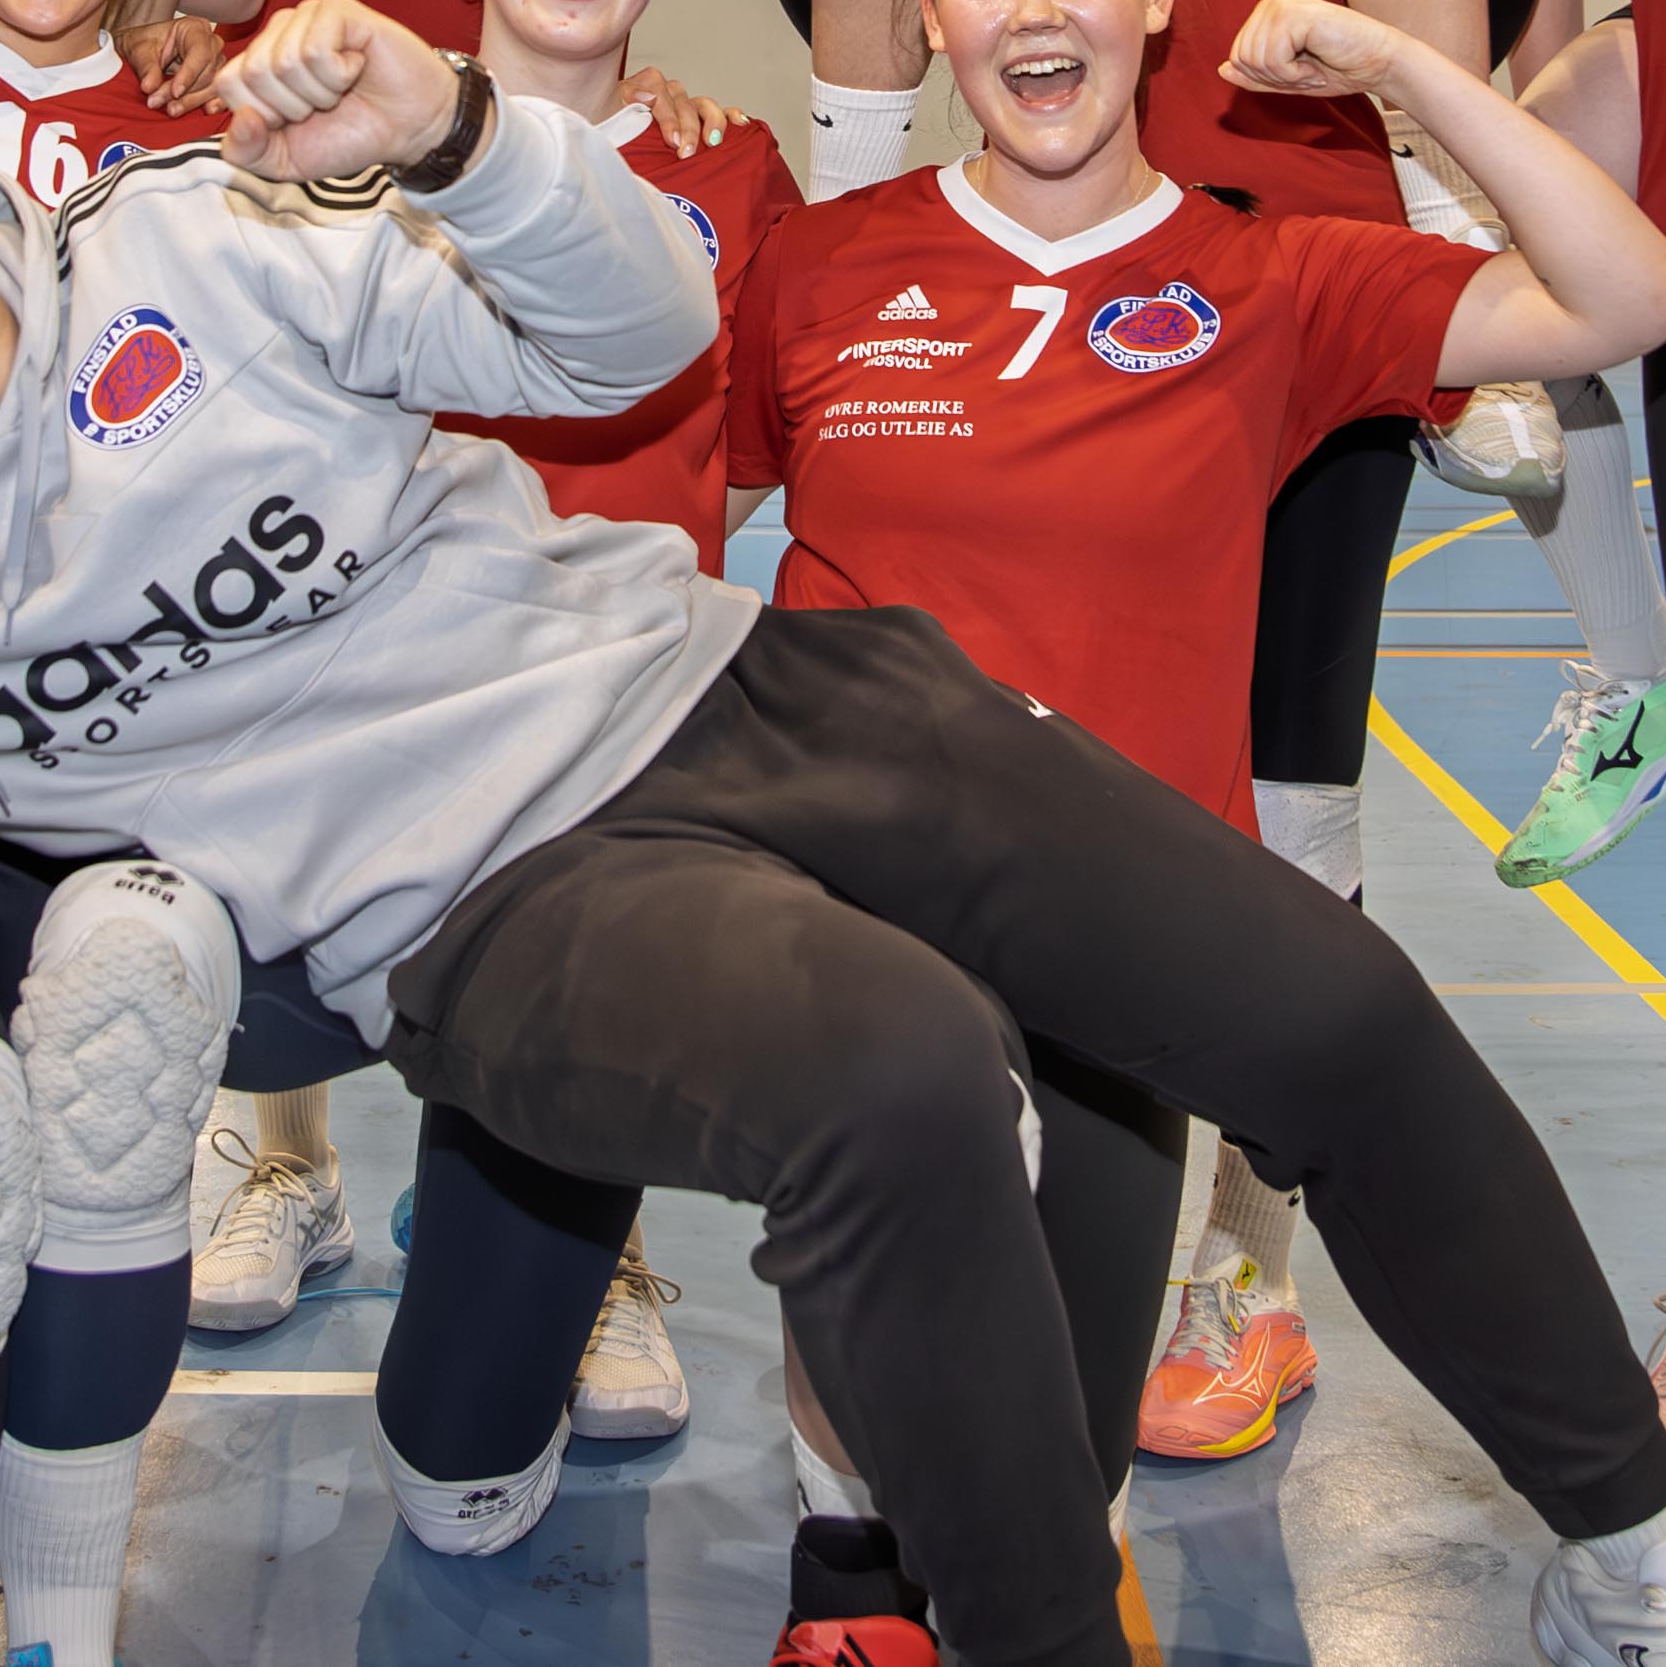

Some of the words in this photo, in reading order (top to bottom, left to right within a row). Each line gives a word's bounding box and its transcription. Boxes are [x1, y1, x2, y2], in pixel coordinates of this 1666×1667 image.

[1119, 286, 1192, 314] FINAD
[877, 306, 938, 321] adidas
[997, 284, 1069, 380] 7
[74, 313, 139, 394] FINSTAD
[852, 337, 973, 360] INTERSPORT
[863, 354, 933, 370] DSVOLL
[866, 400, 964, 415] ROMERIKE
[851, 422, 877, 438] OG
[881, 421, 946, 436] UTLEIE
[949, 422, 974, 437] AS
[30, 548, 365, 770] SORTSEAR
